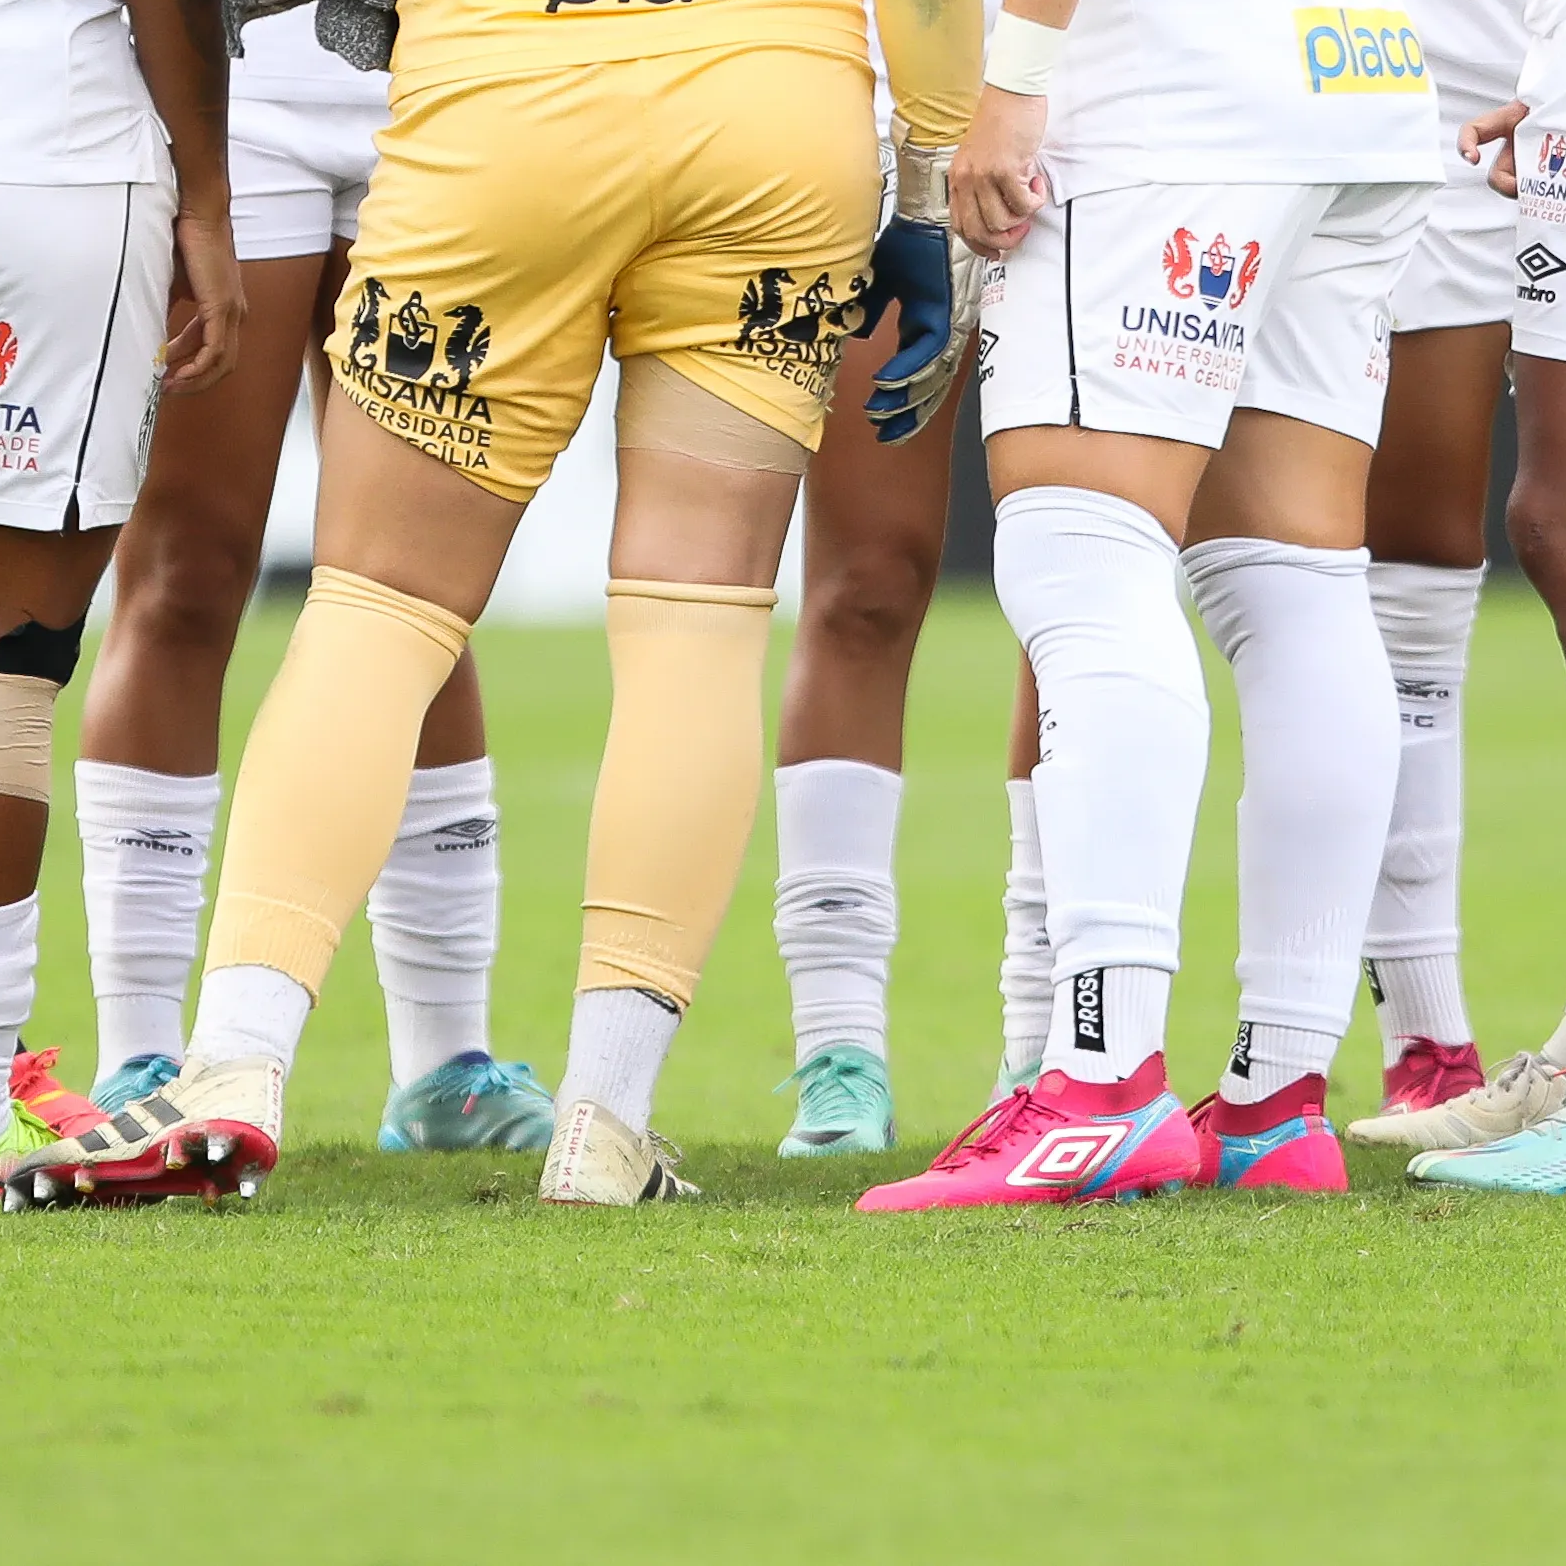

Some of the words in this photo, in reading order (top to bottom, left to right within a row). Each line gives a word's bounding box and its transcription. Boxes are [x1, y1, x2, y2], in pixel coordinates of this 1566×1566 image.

[1306, 8, 1424, 94] placo
[1122, 305, 1244, 355] UNISANTA
[341, 360, 492, 425] UNISANTA
[1114, 353, 1187, 380] SANTA
